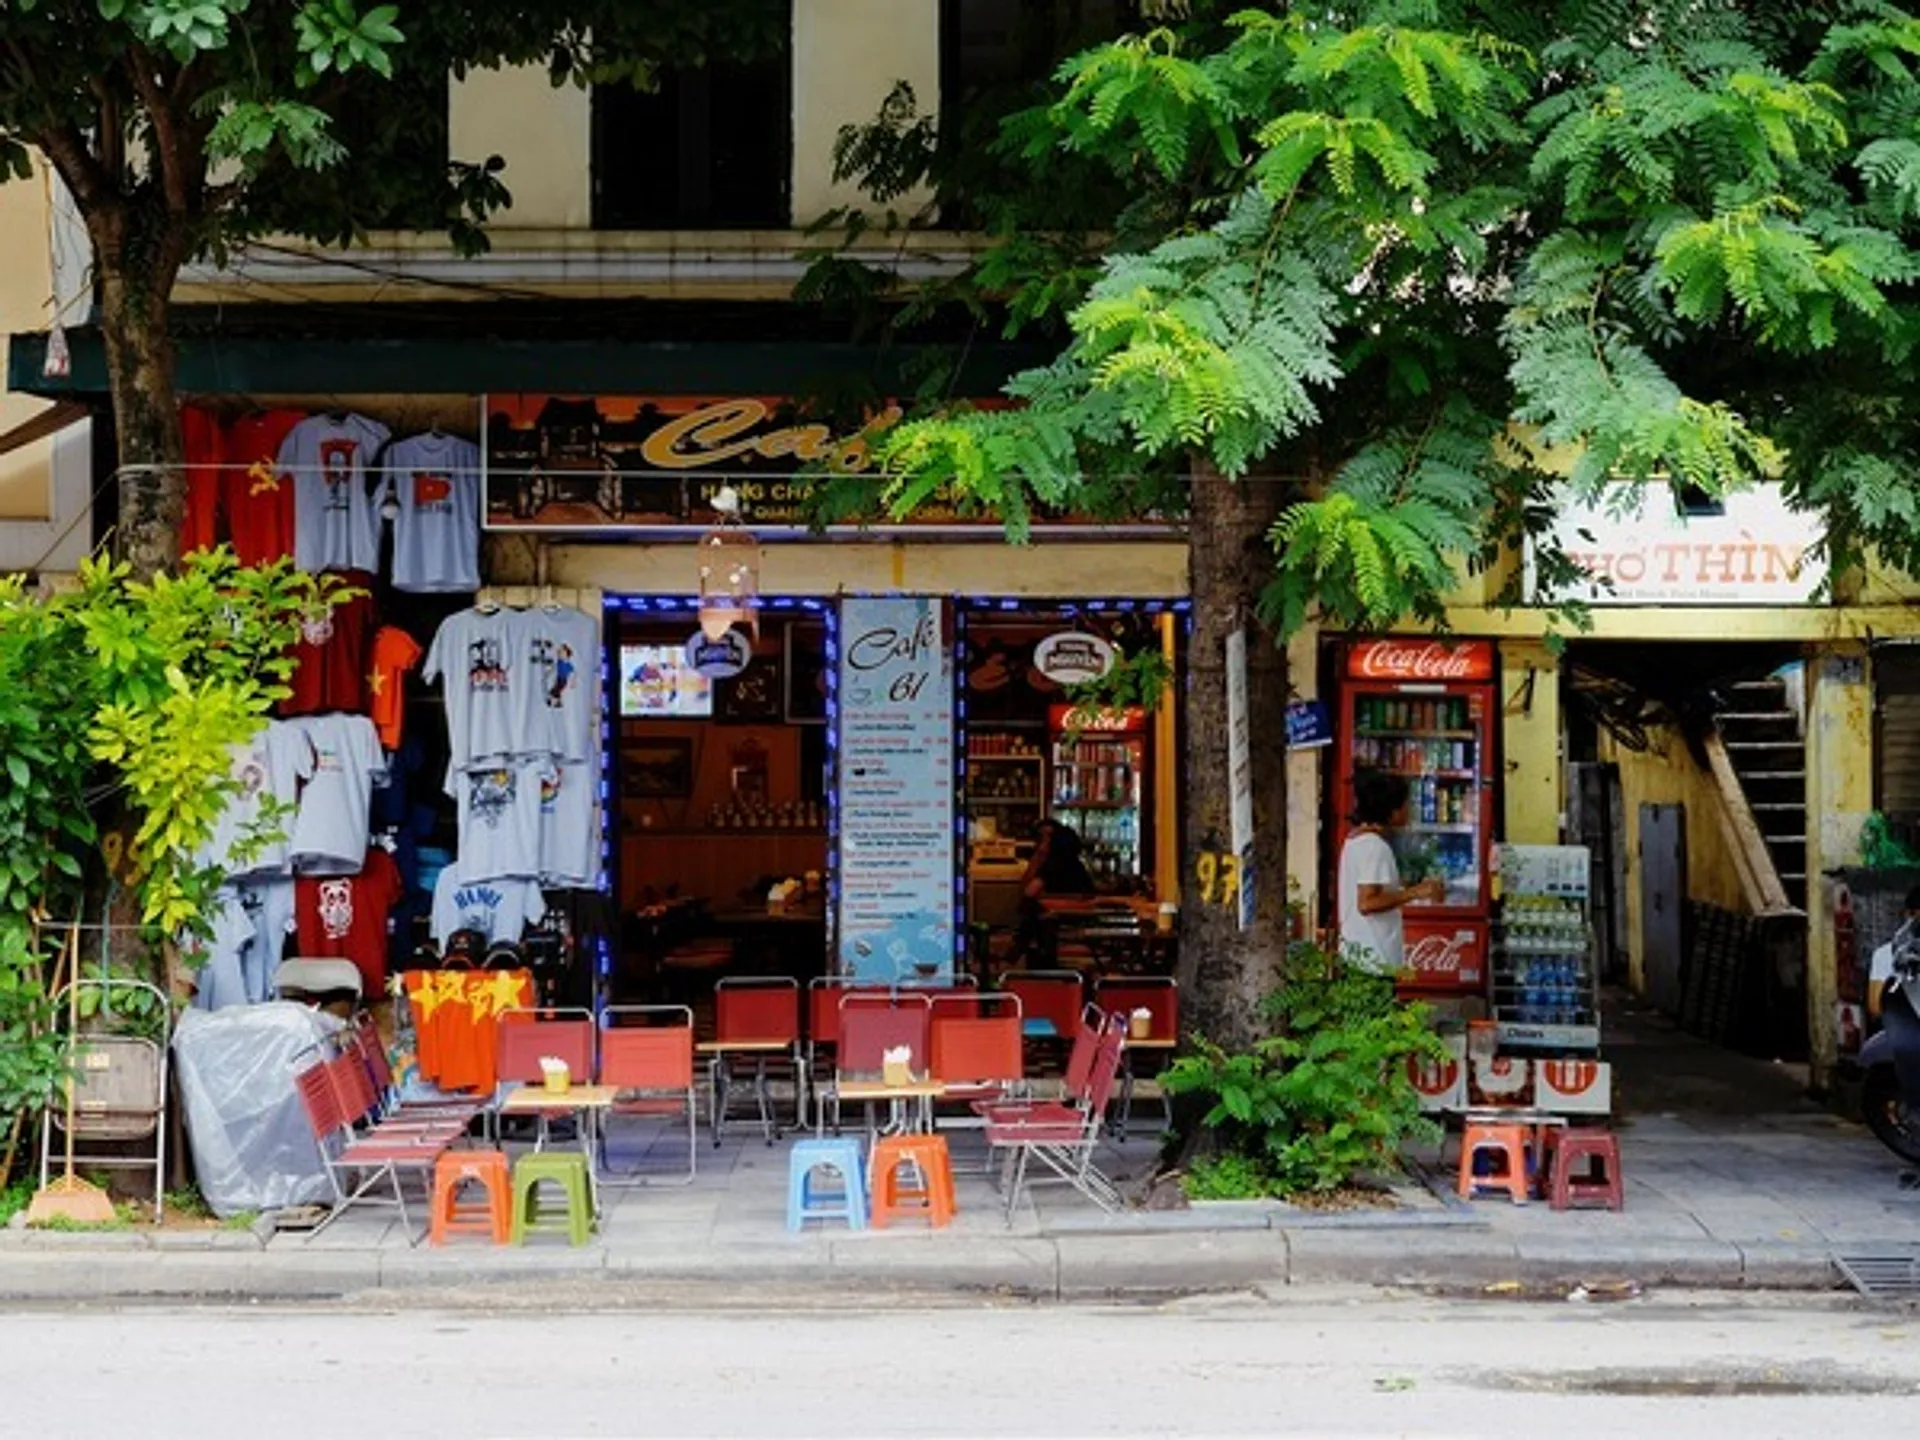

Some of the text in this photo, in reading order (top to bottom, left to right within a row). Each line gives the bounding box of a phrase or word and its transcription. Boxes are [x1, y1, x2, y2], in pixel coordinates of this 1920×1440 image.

[1655, 529, 1805, 584] THÌN
[847, 611, 937, 671] Café
[1362, 640, 1476, 678] Coca-Cola
